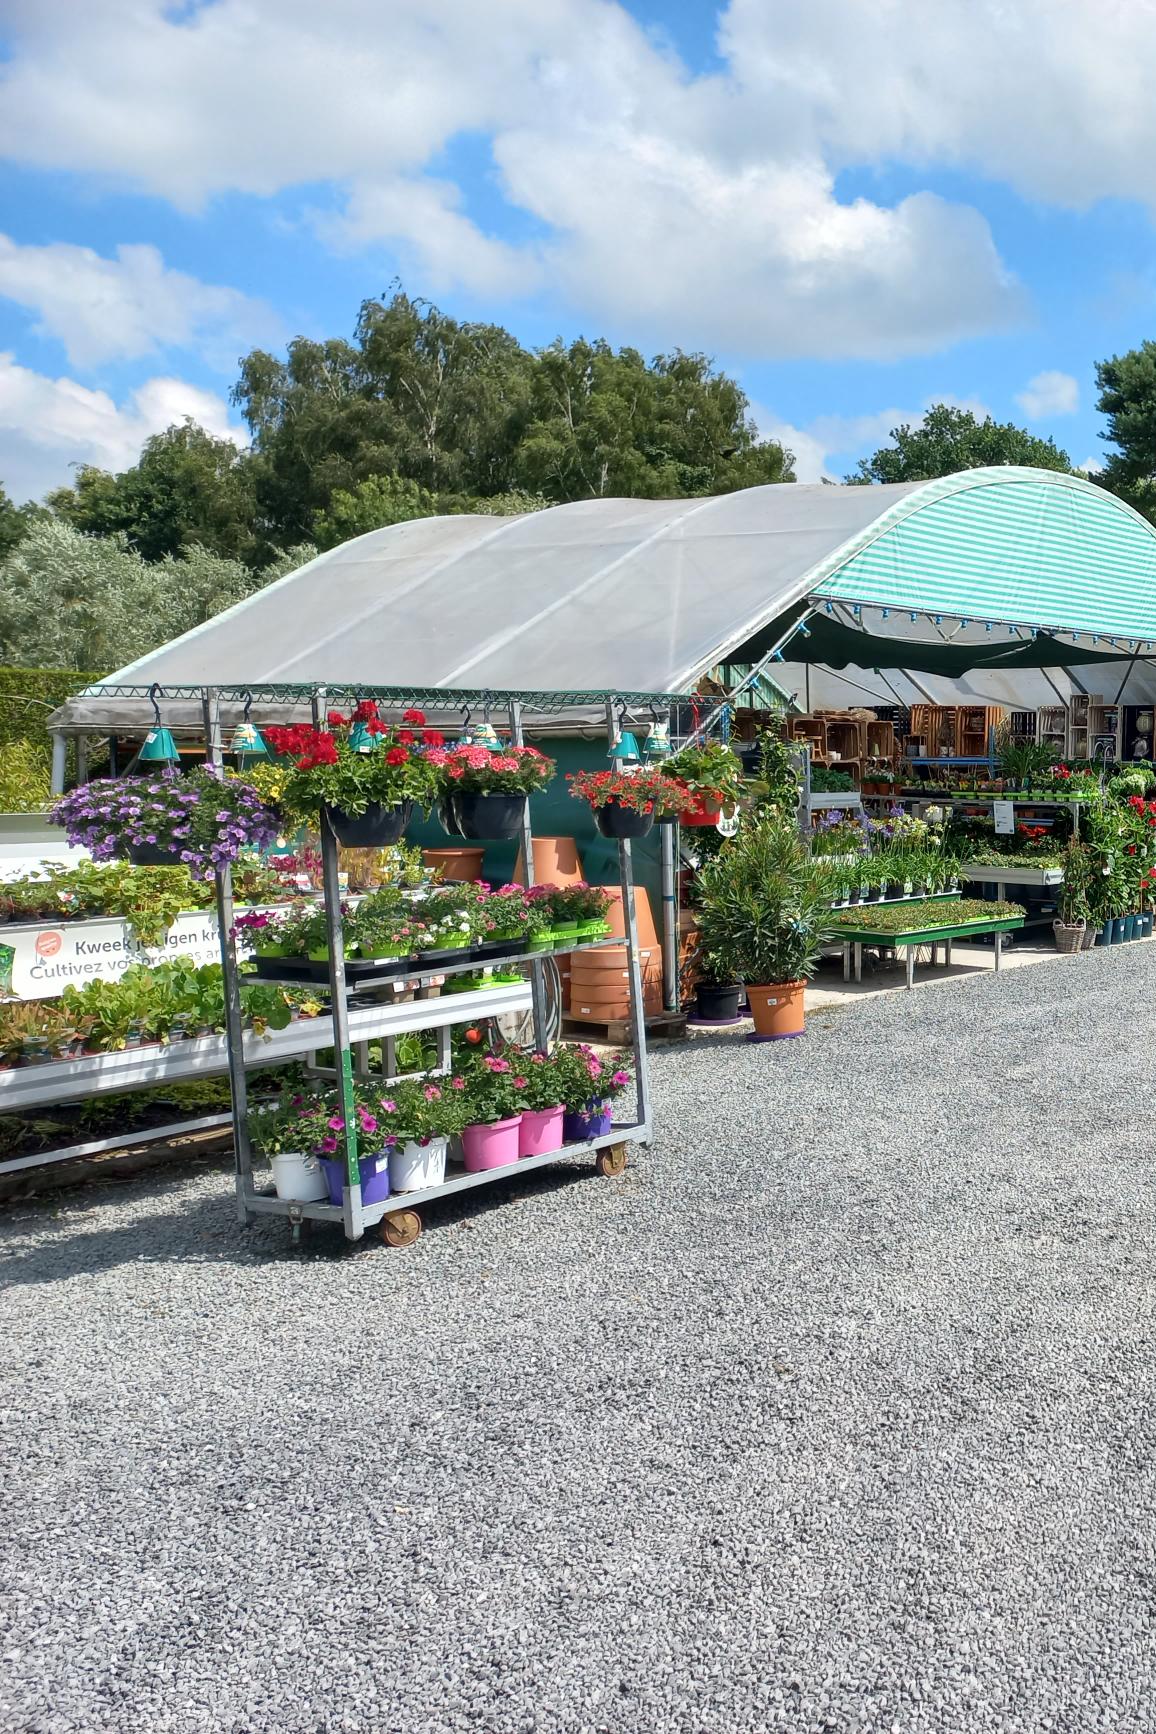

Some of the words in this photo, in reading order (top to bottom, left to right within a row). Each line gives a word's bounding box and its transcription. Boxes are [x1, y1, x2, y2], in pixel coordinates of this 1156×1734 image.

[75, 937, 131, 956] Kweek
[153, 932, 197, 948] igen
[29, 961, 103, 980] Cultivez
[141, 950, 201, 967] propes
